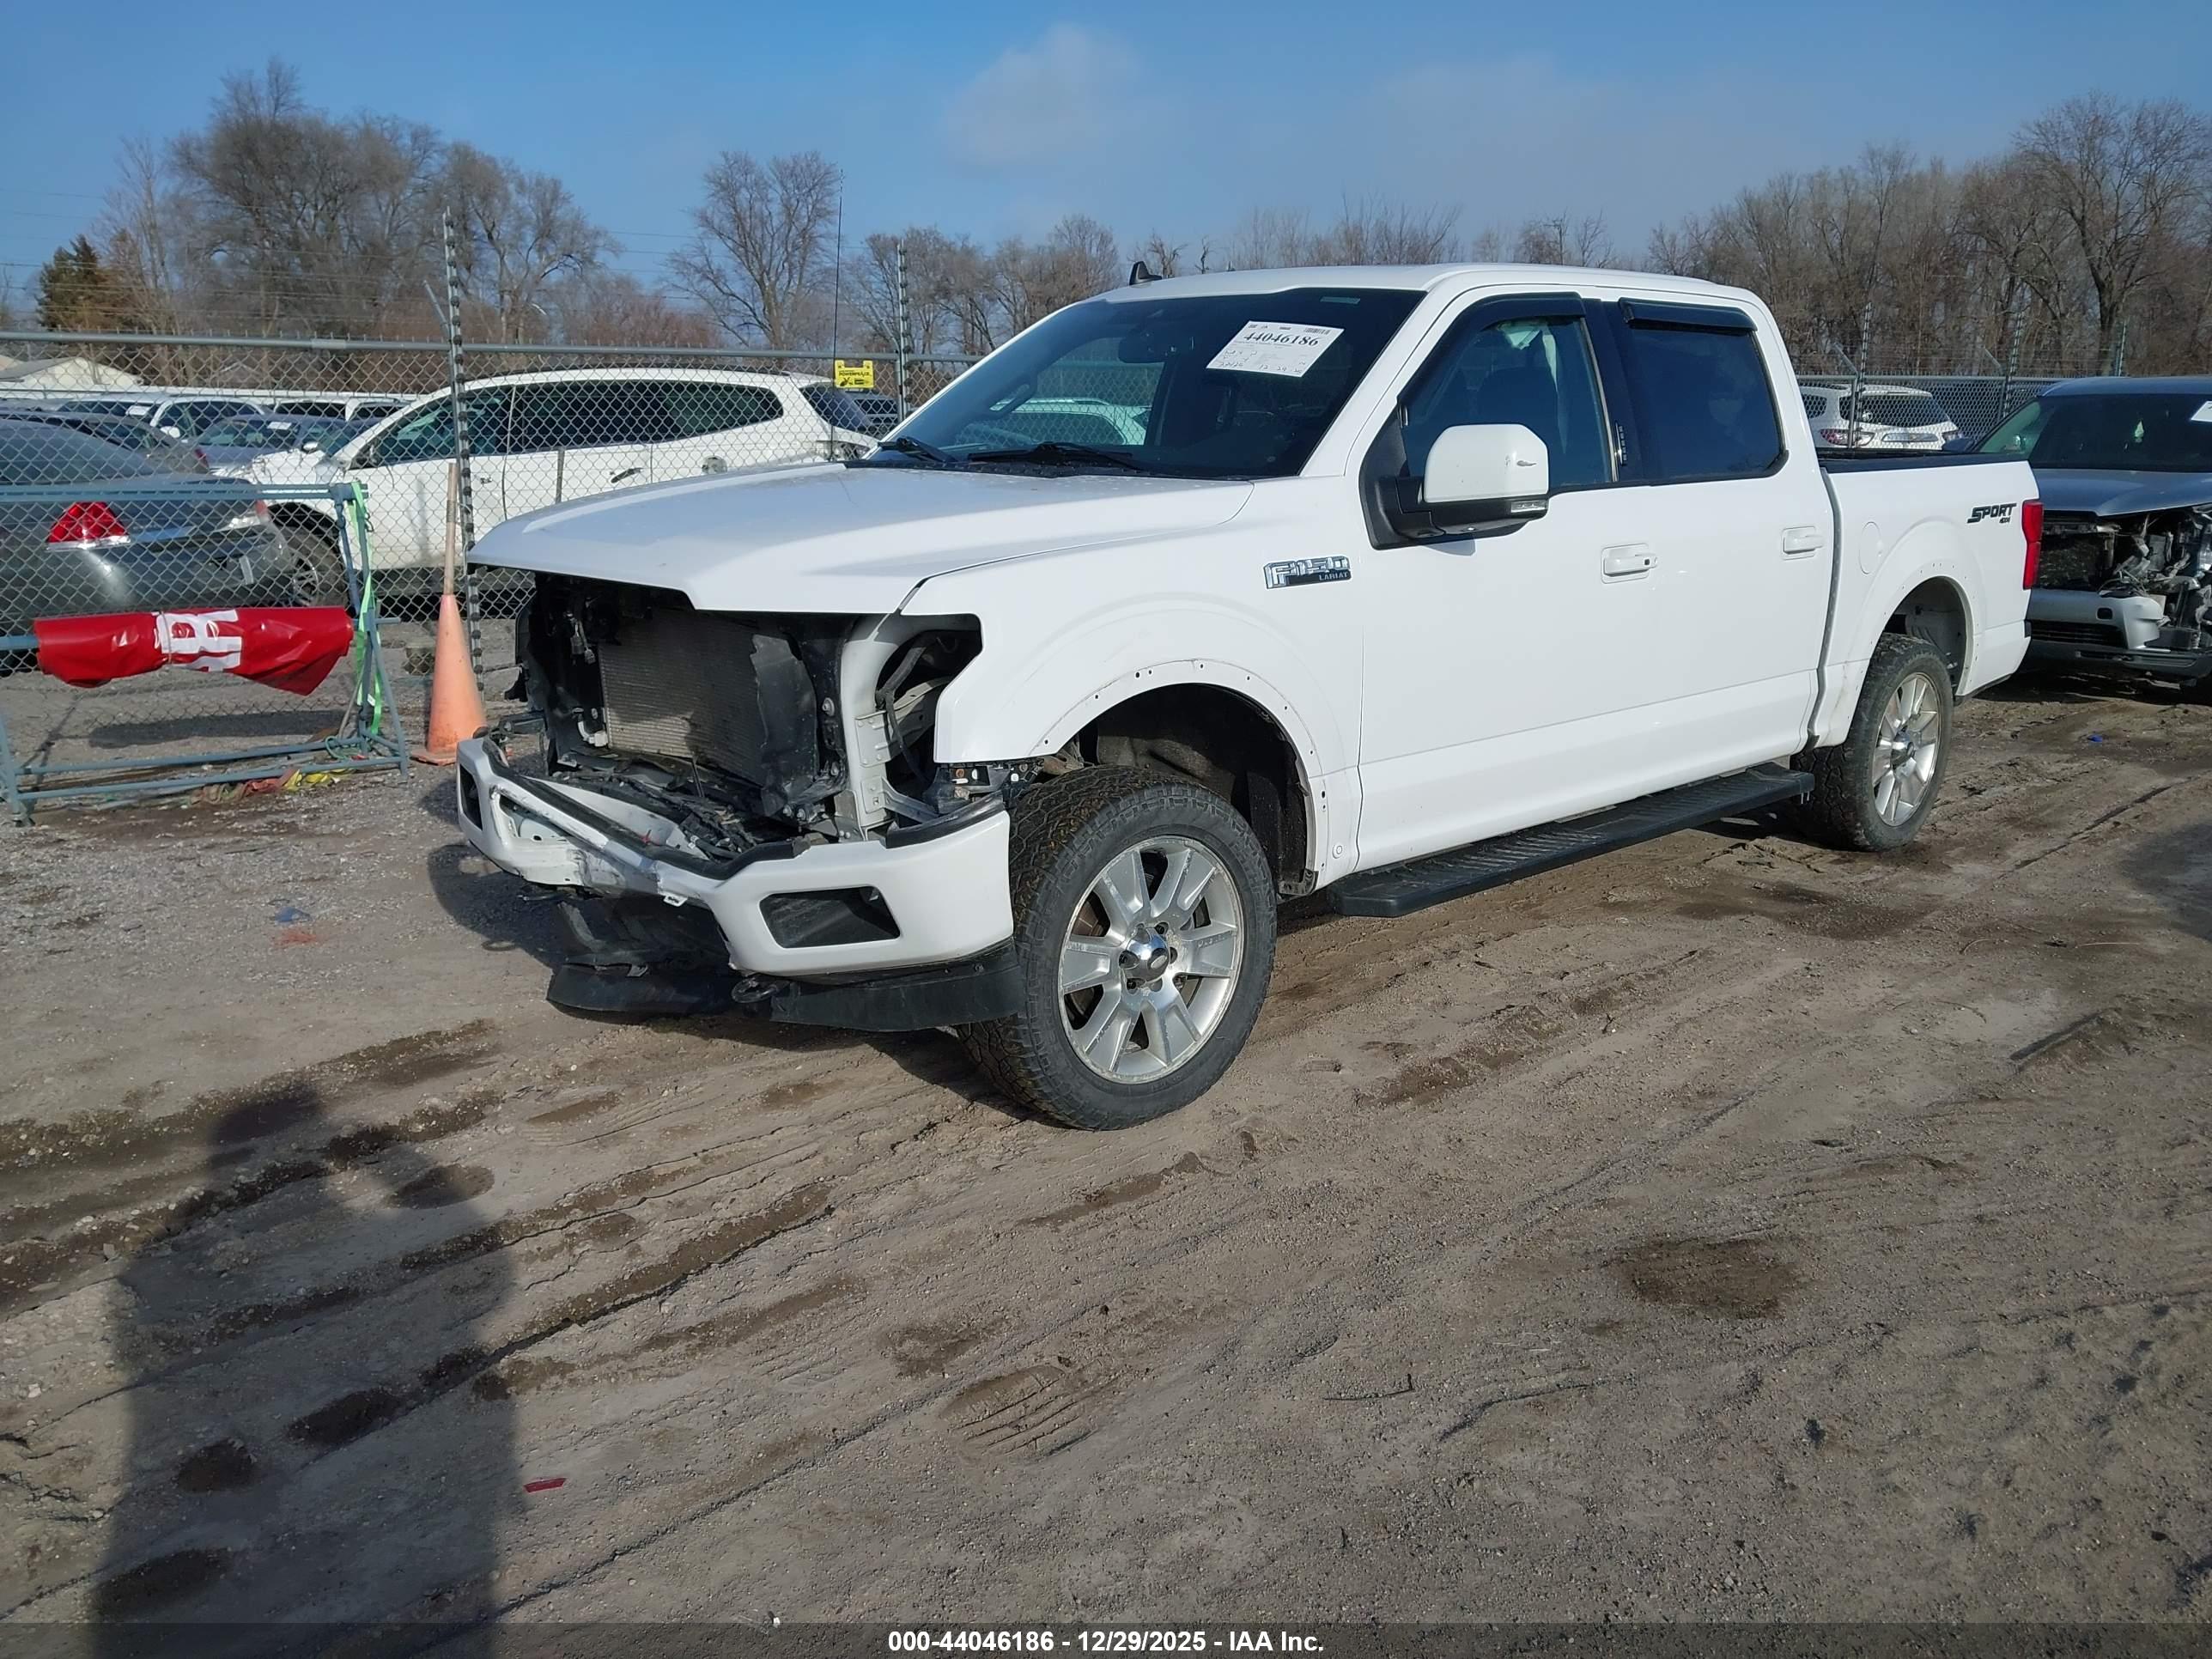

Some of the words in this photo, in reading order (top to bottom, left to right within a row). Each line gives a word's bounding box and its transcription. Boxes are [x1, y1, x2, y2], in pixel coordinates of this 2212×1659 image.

[1243, 331, 1322, 347] 44046186
[1966, 503, 2017, 524] SPORT
[1319, 572, 1348, 580] LARIAT
